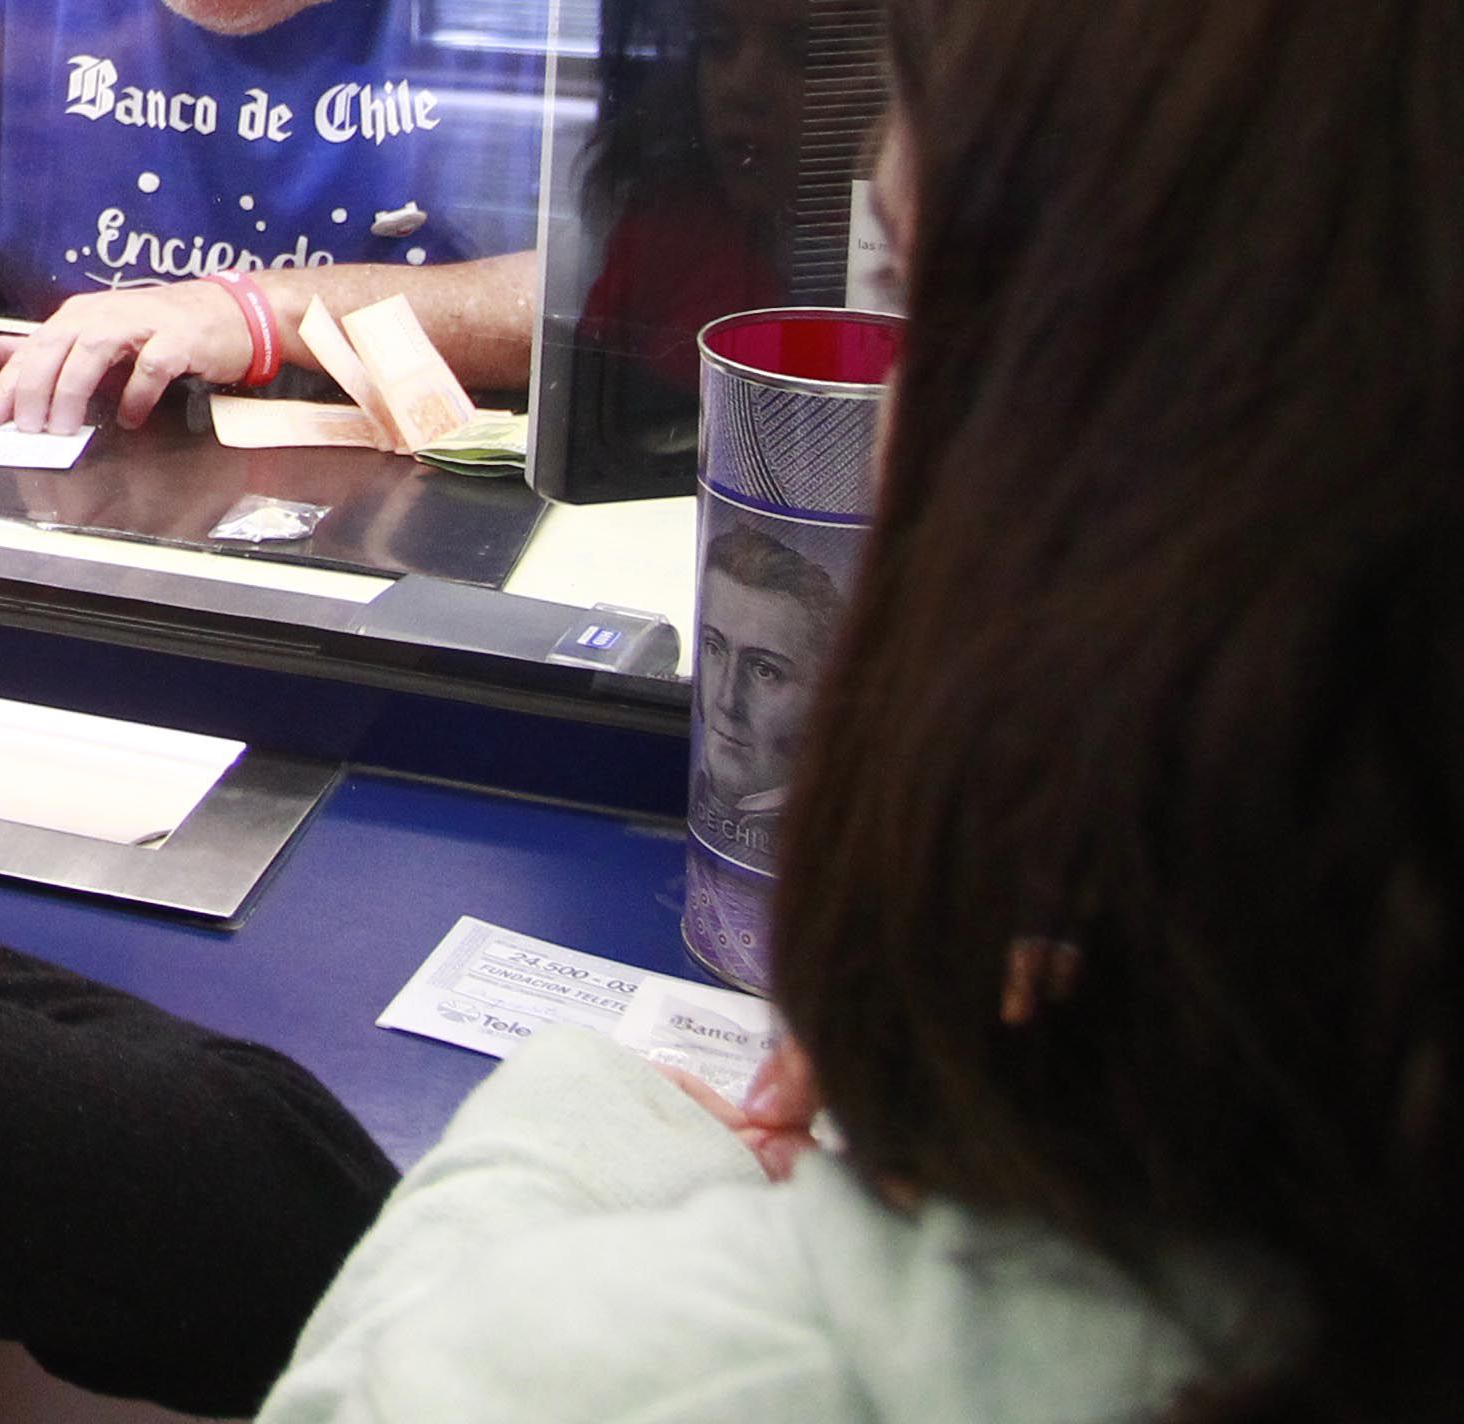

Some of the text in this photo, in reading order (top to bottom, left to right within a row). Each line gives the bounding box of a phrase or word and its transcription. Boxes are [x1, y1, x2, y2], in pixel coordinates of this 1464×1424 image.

[65, 55, 441, 146] Banco de Chile
[479, 964, 571, 994] FUNDACION
[482, 1014, 532, 1037] Tele
[669, 1014, 749, 1046] Banco
